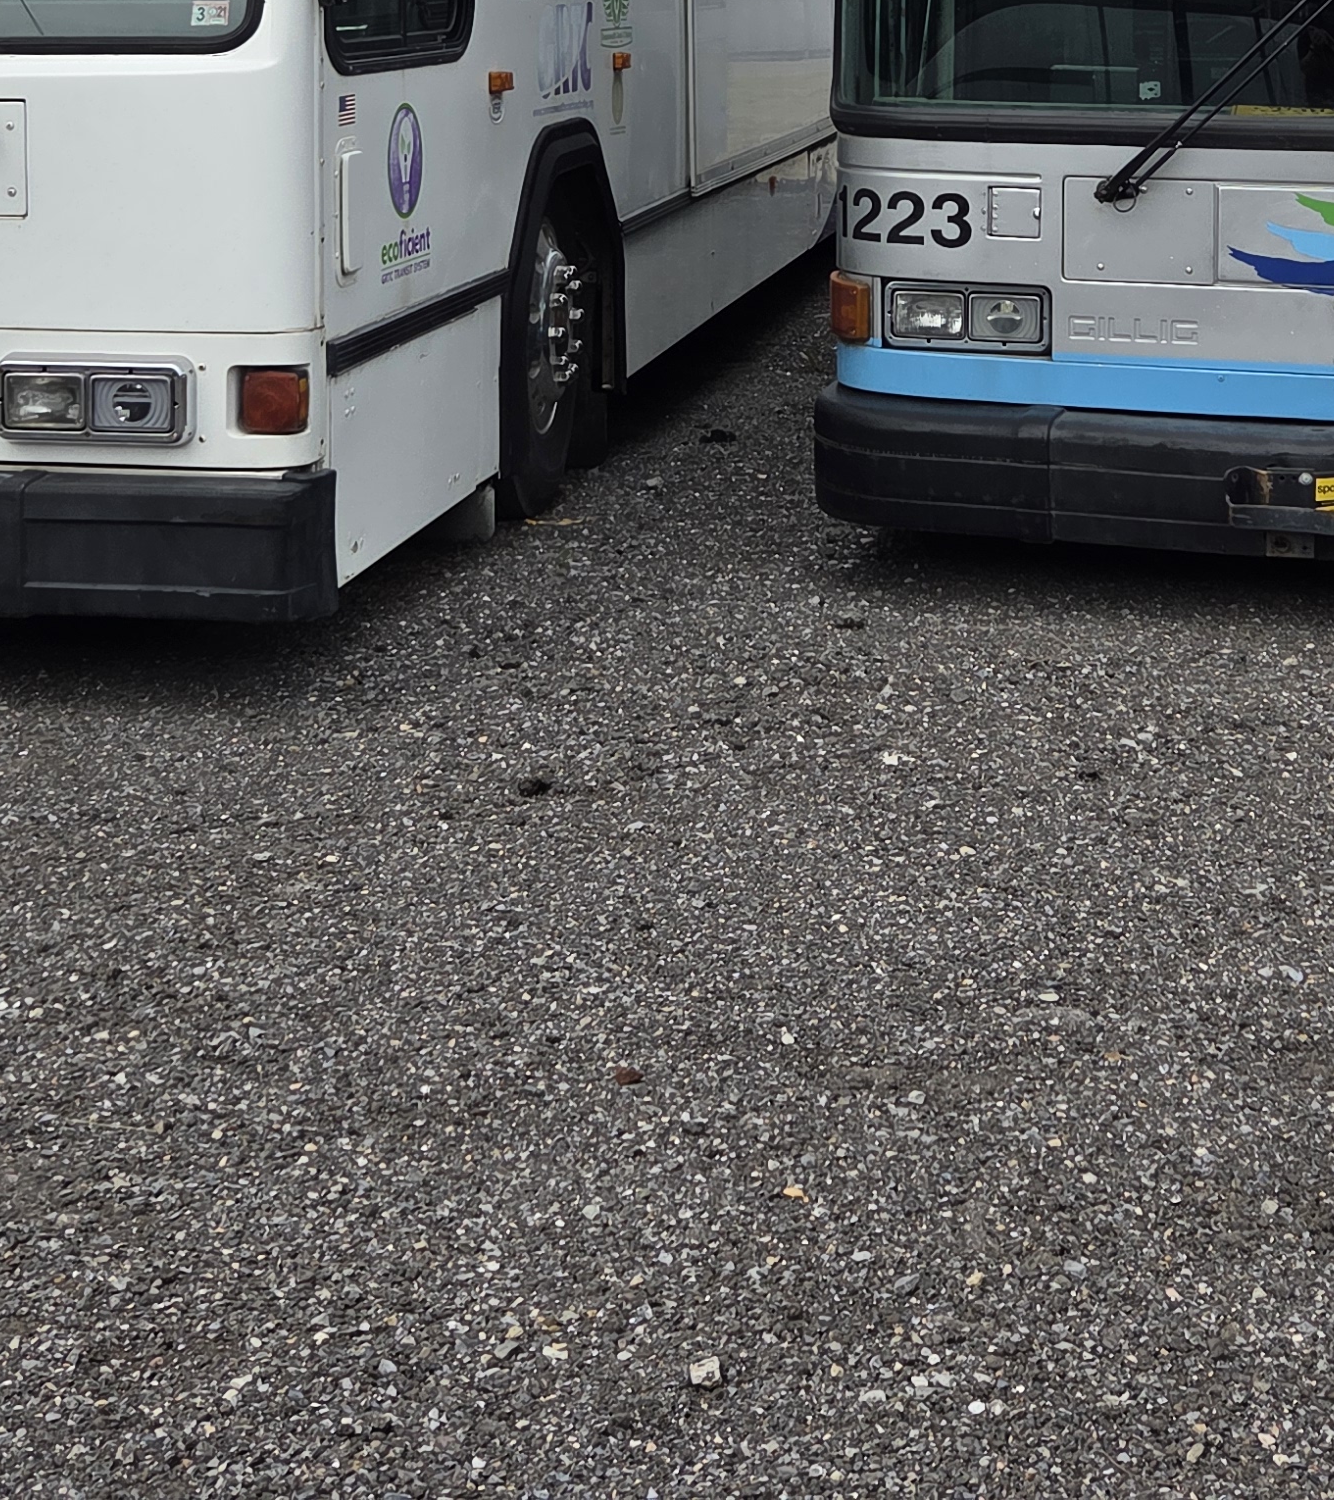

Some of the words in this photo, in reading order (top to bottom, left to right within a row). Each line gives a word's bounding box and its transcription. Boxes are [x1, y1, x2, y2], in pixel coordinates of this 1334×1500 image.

[196, 6, 206, 21] 3
[839, 185, 972, 248] 1223
[381, 226, 430, 265] ecoficient
[1068, 315, 1198, 345] GILLIG
